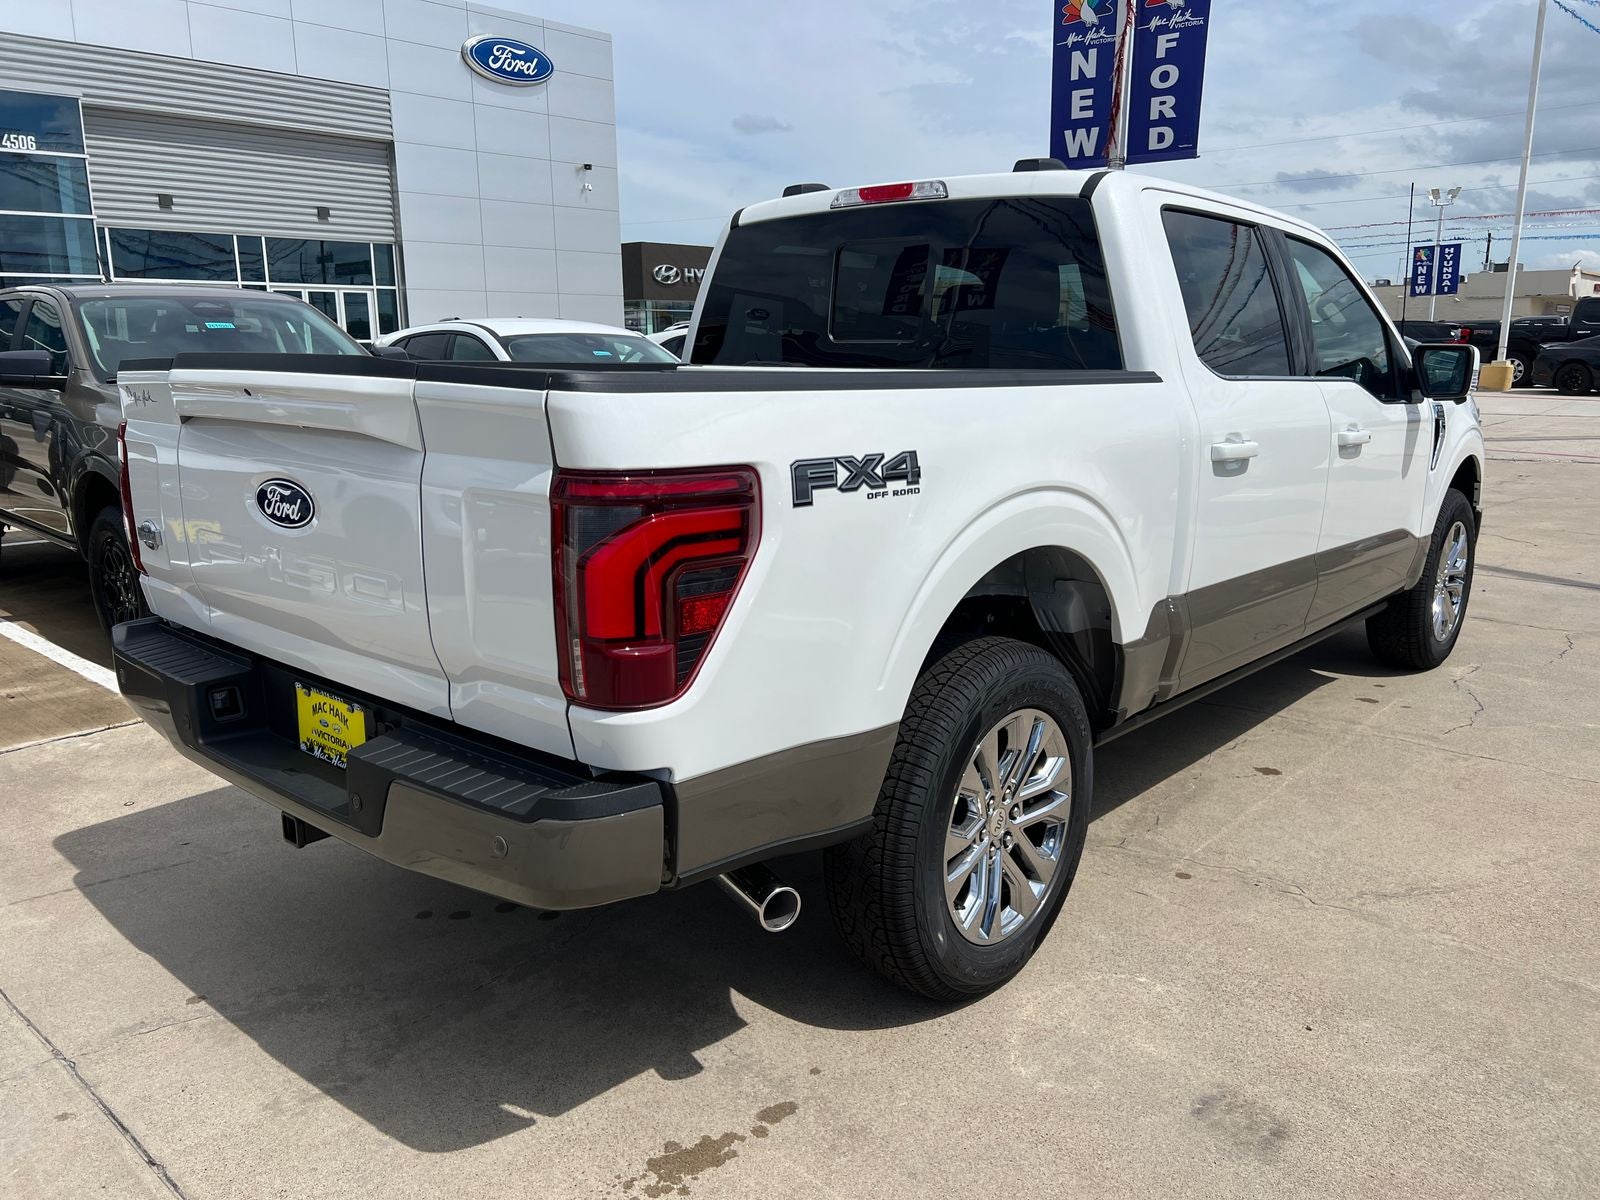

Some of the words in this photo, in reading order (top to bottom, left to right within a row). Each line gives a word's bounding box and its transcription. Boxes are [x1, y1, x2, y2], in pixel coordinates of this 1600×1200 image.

[1137, 15, 1169, 32] Mac
[1174, 20, 1204, 29] VICTORIA
[1056, 32, 1085, 48] Mac
[1090, 37, 1117, 45] VICTORIA
[488, 44, 538, 76] Ford
[1064, 48, 1100, 159] NEW
[1148, 32, 1180, 151] FORD
[2, 133, 36, 151] 4506
[1415, 265, 1427, 294] NEW
[1441, 247, 1454, 292] HYUNDAI
[790, 450, 921, 508] FX4
[867, 491, 889, 500] OFF
[892, 487, 921, 498] ROAD
[264, 486, 302, 521] Ford
[312, 701, 328, 717] MAC
[329, 703, 349, 730] HAIK
[331, 755, 347, 769] Hai
